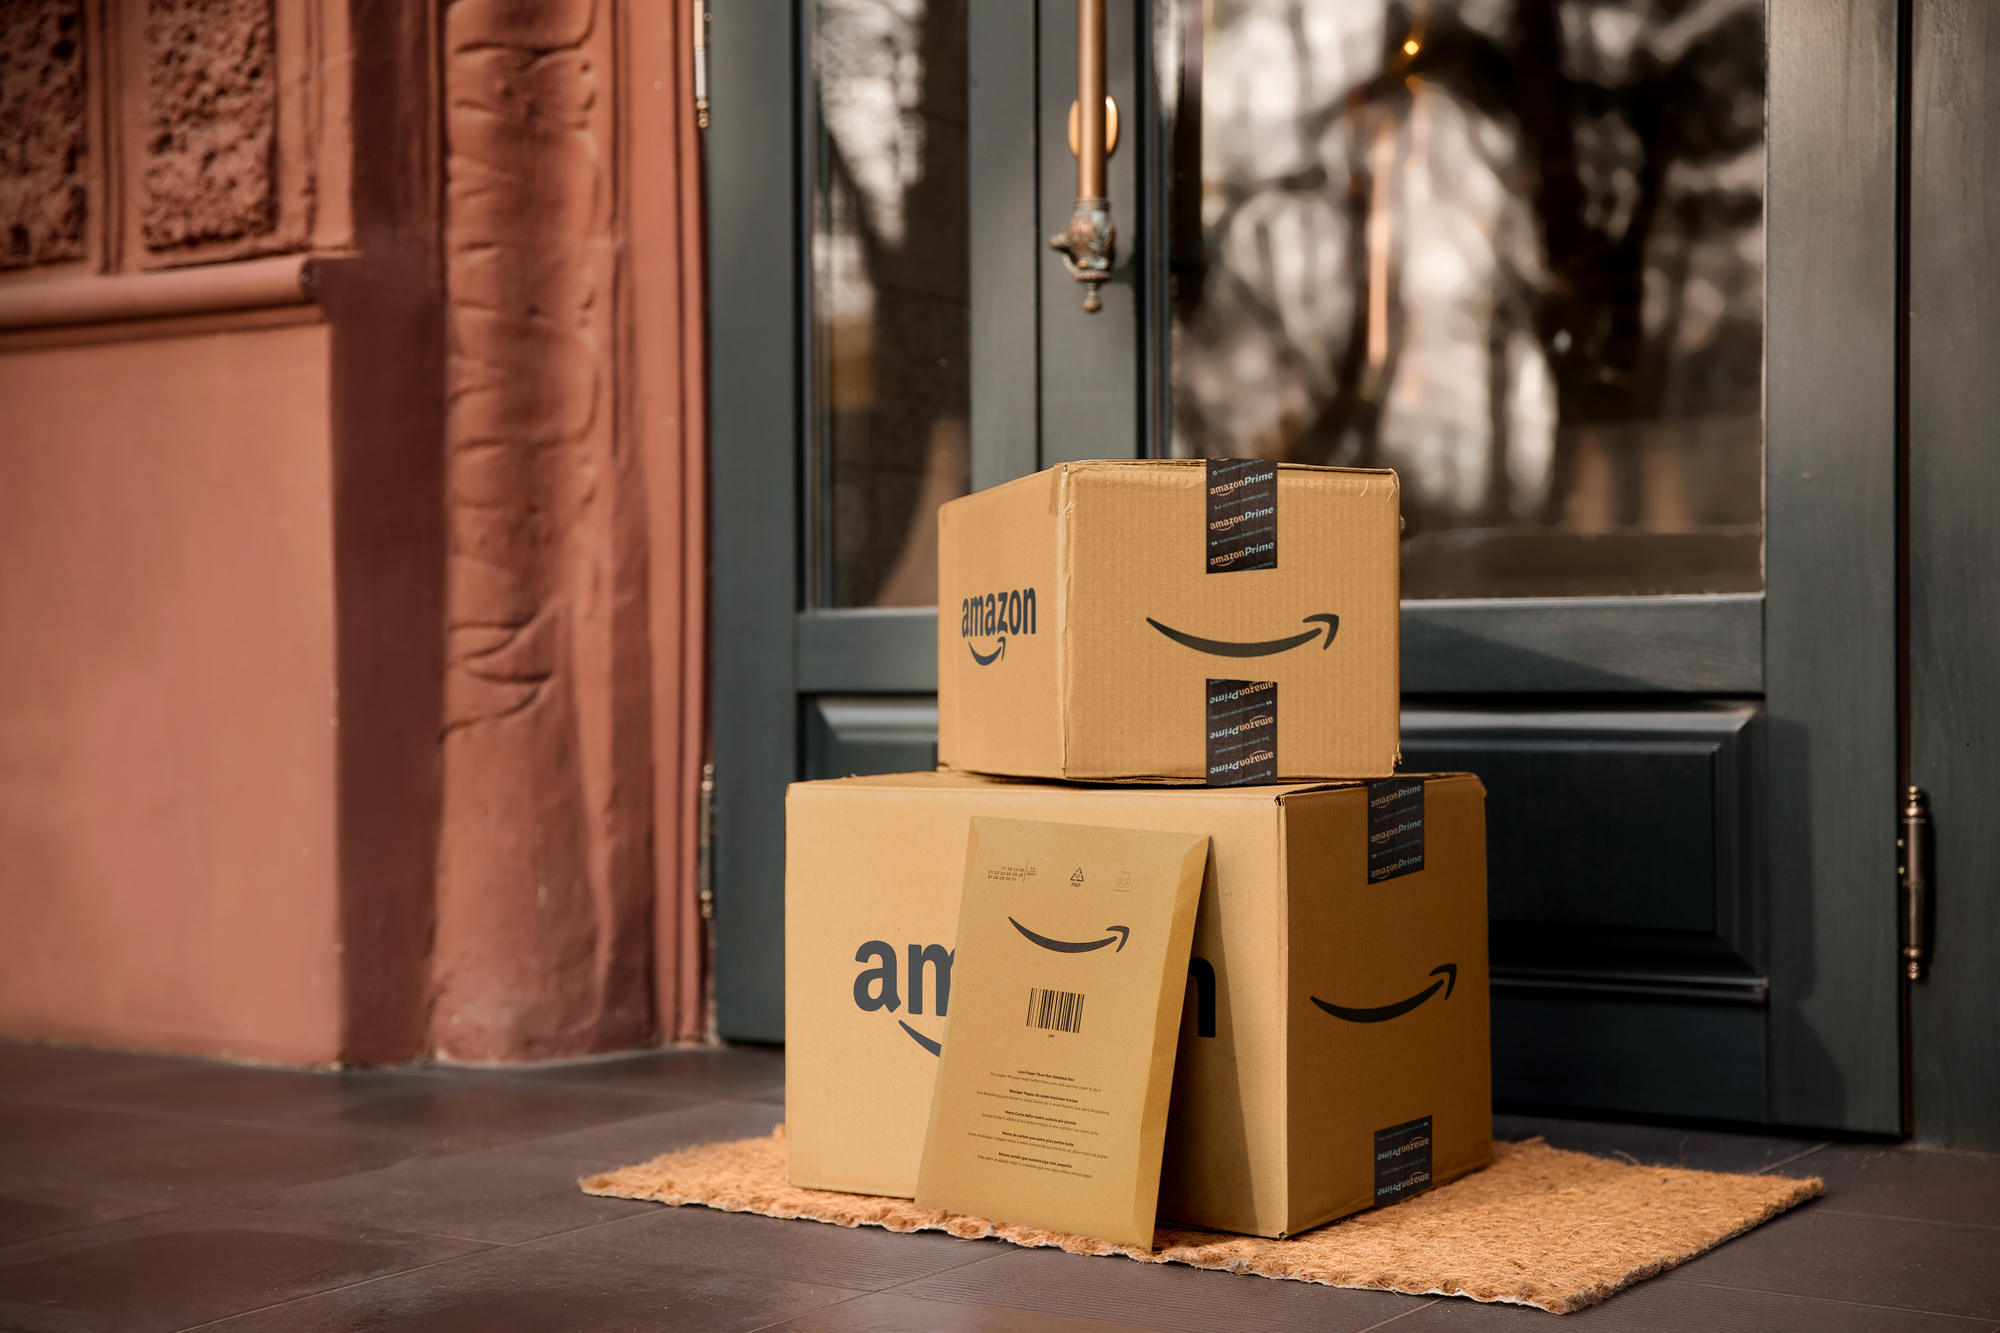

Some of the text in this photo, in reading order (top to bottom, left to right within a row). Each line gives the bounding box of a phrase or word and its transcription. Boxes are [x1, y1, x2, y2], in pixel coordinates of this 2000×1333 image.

[1209, 472, 1274, 495] amazonPrime
[1209, 506, 1274, 530] amazonPrime
[1209, 542, 1274, 566] amazonPrime
[962, 587, 1036, 638] amazon
[1209, 681, 1274, 704] amazonPrime
[1209, 716, 1274, 739] amazonPrime
[1209, 751, 1274, 774] amazonPrime
[1370, 785, 1422, 808] amazonPrime
[1370, 820, 1422, 842] amazonPrime
[1370, 855, 1422, 878] amazonPrime
[1377, 1172, 1430, 1196] amazonPrime
